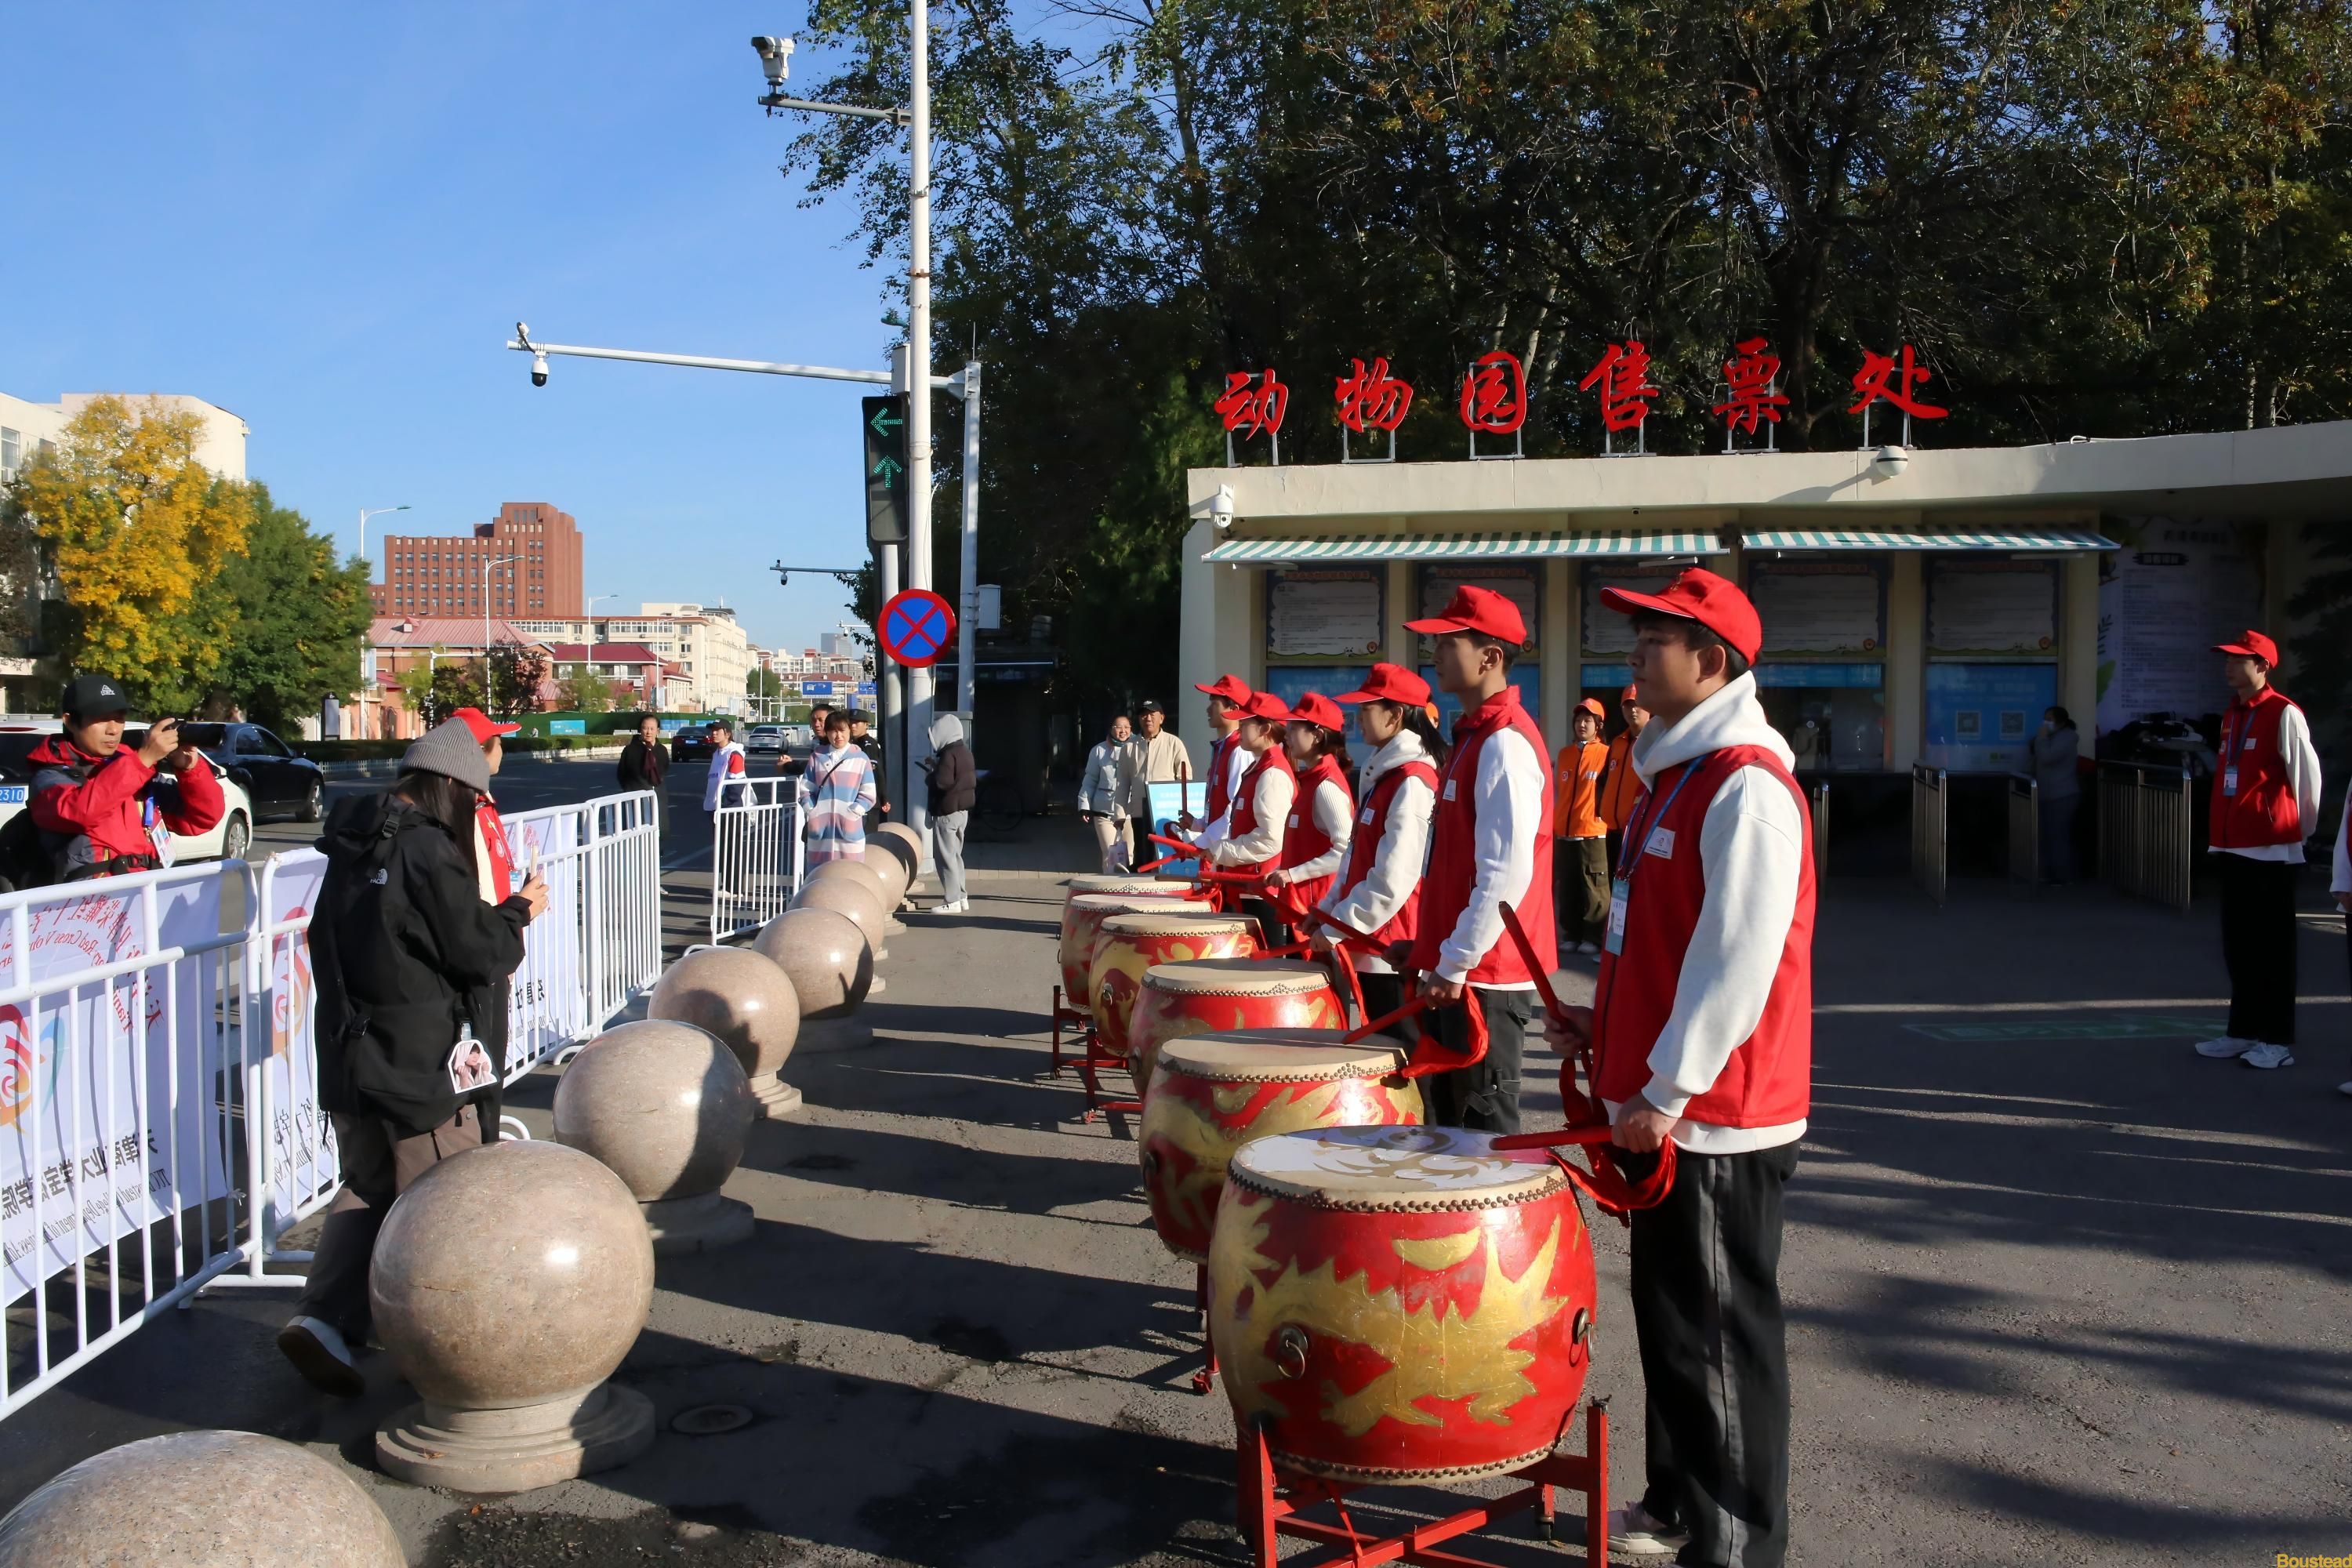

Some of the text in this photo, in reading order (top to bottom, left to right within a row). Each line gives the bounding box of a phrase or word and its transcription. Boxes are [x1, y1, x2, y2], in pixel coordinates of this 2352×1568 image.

[1214, 337, 1948, 441] 动物园售票处
